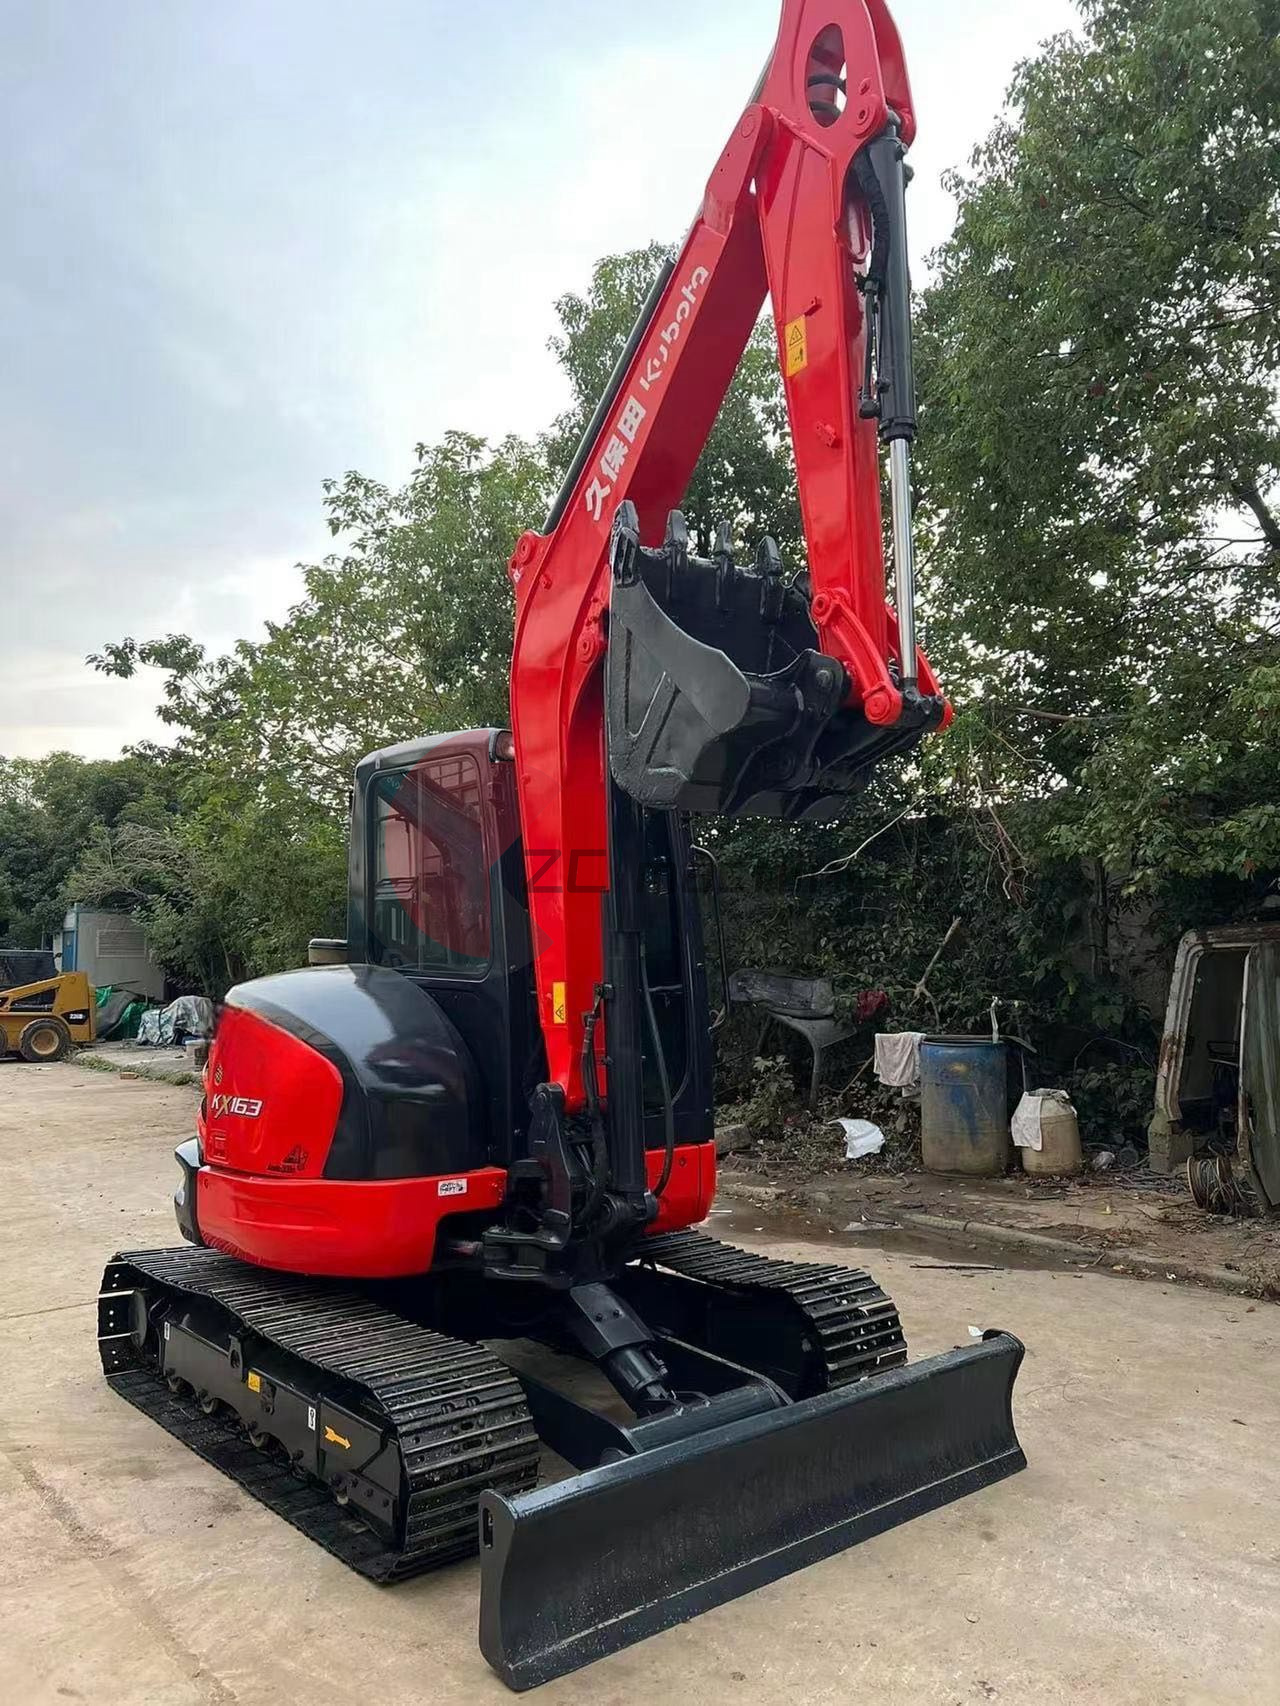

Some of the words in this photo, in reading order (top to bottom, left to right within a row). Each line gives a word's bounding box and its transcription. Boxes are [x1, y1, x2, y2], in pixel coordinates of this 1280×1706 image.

[585, 395, 646, 521] 久保田
[639, 266, 709, 391] Kubota
[211, 1093, 263, 1119] KX163
